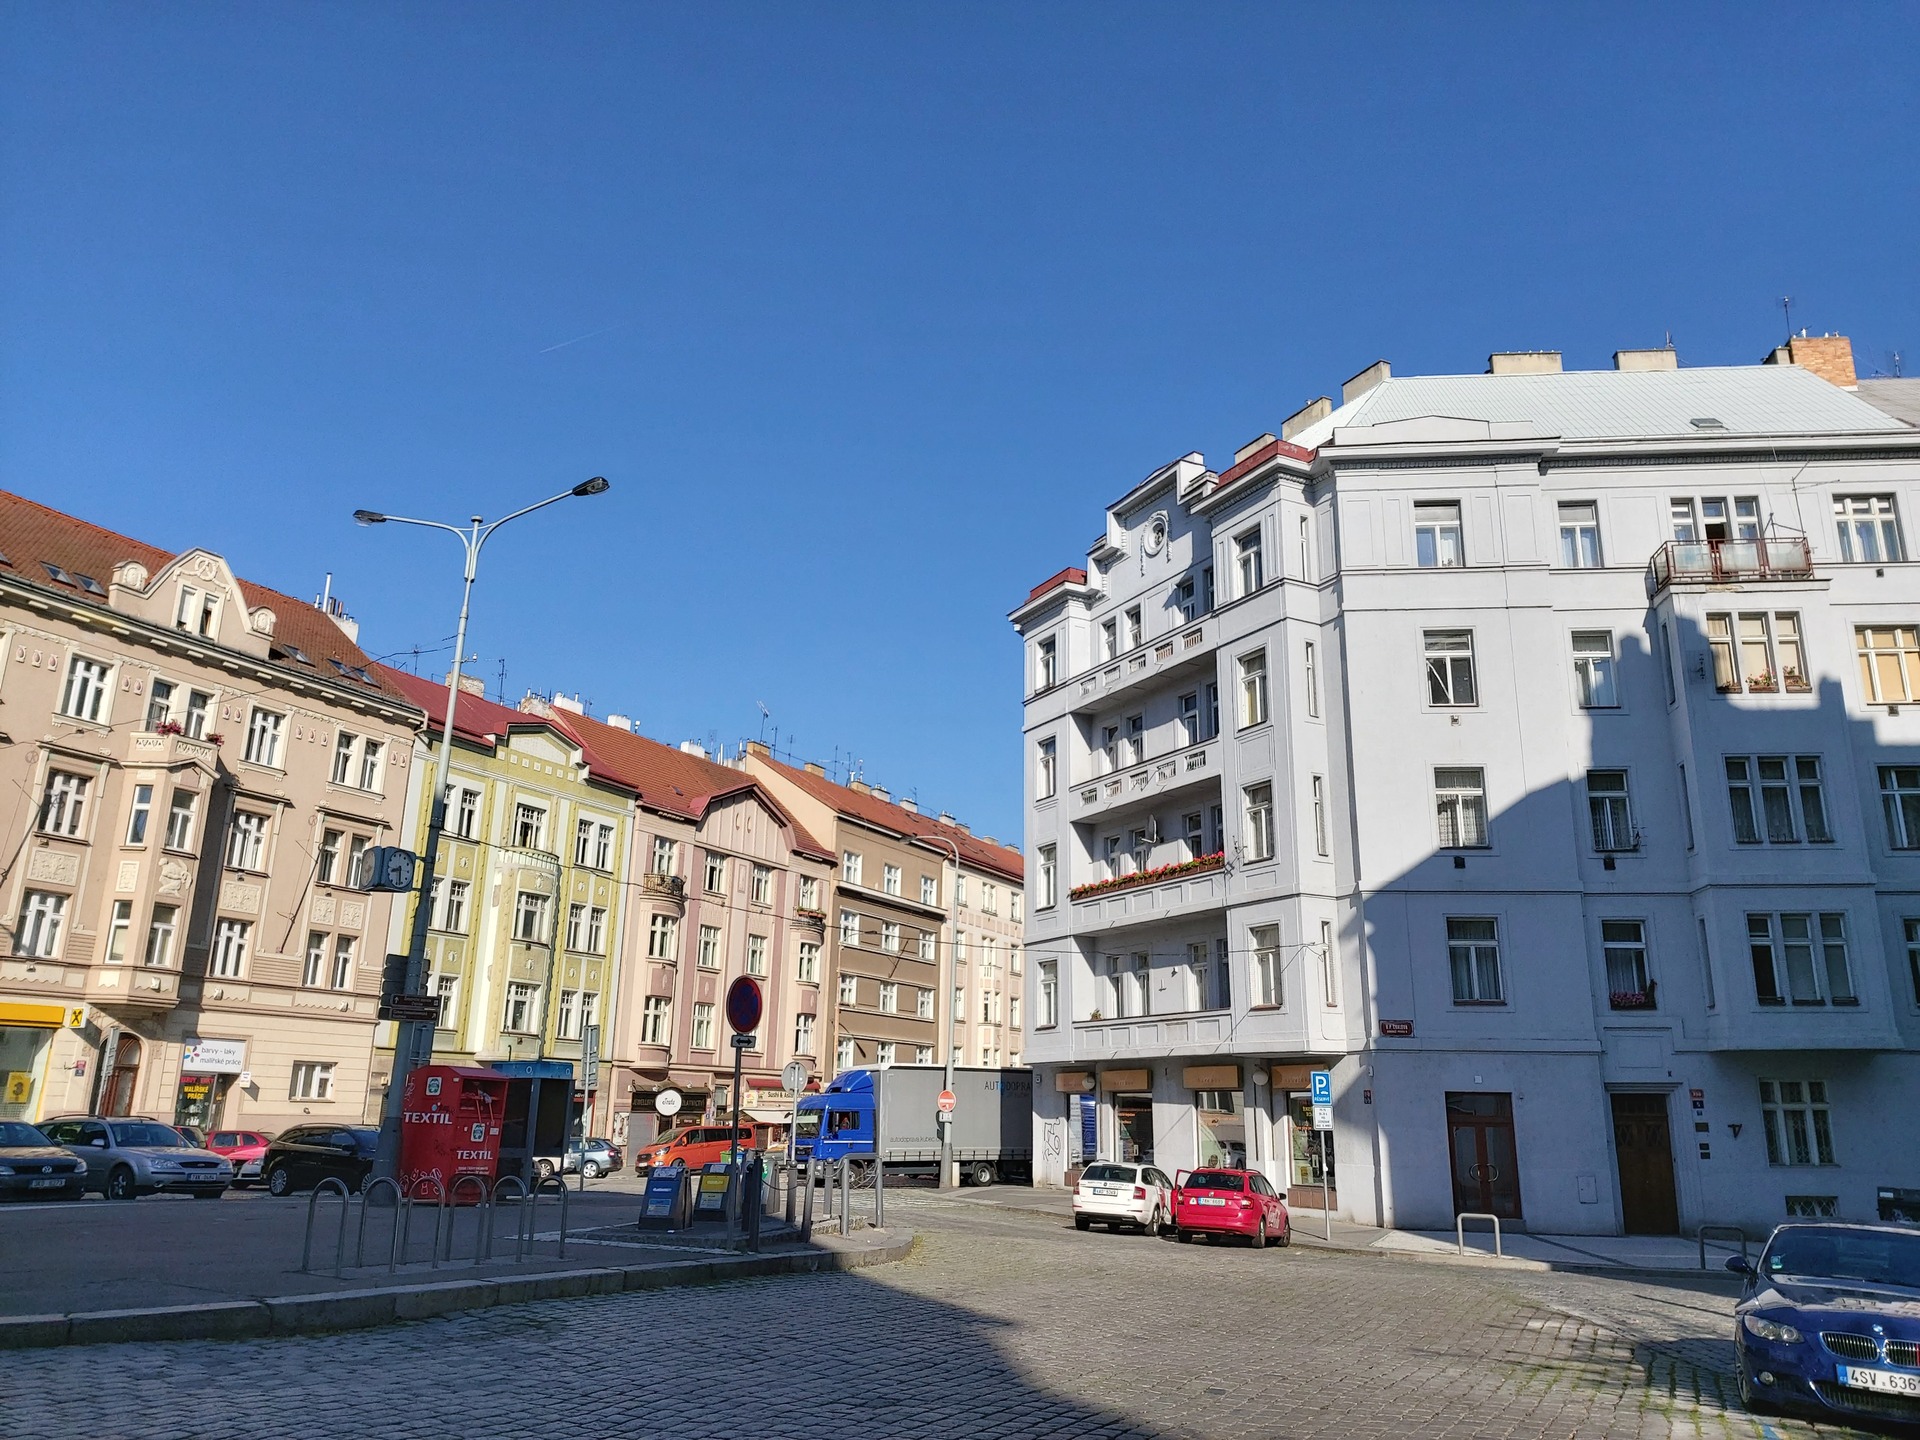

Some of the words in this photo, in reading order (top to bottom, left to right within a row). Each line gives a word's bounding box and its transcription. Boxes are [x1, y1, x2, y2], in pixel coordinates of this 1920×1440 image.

[201, 1047, 221, 1055] barvy
[224, 1048, 237, 1056] laky
[200, 1057, 224, 1065] malířské
[225, 1058, 241, 1066] práce
[1315, 1075, 1327, 1094] P
[403, 1112, 453, 1124] TEXTIL
[456, 1150, 493, 1160] TEXTIL
[1851, 1370, 1877, 1385] 4SV
